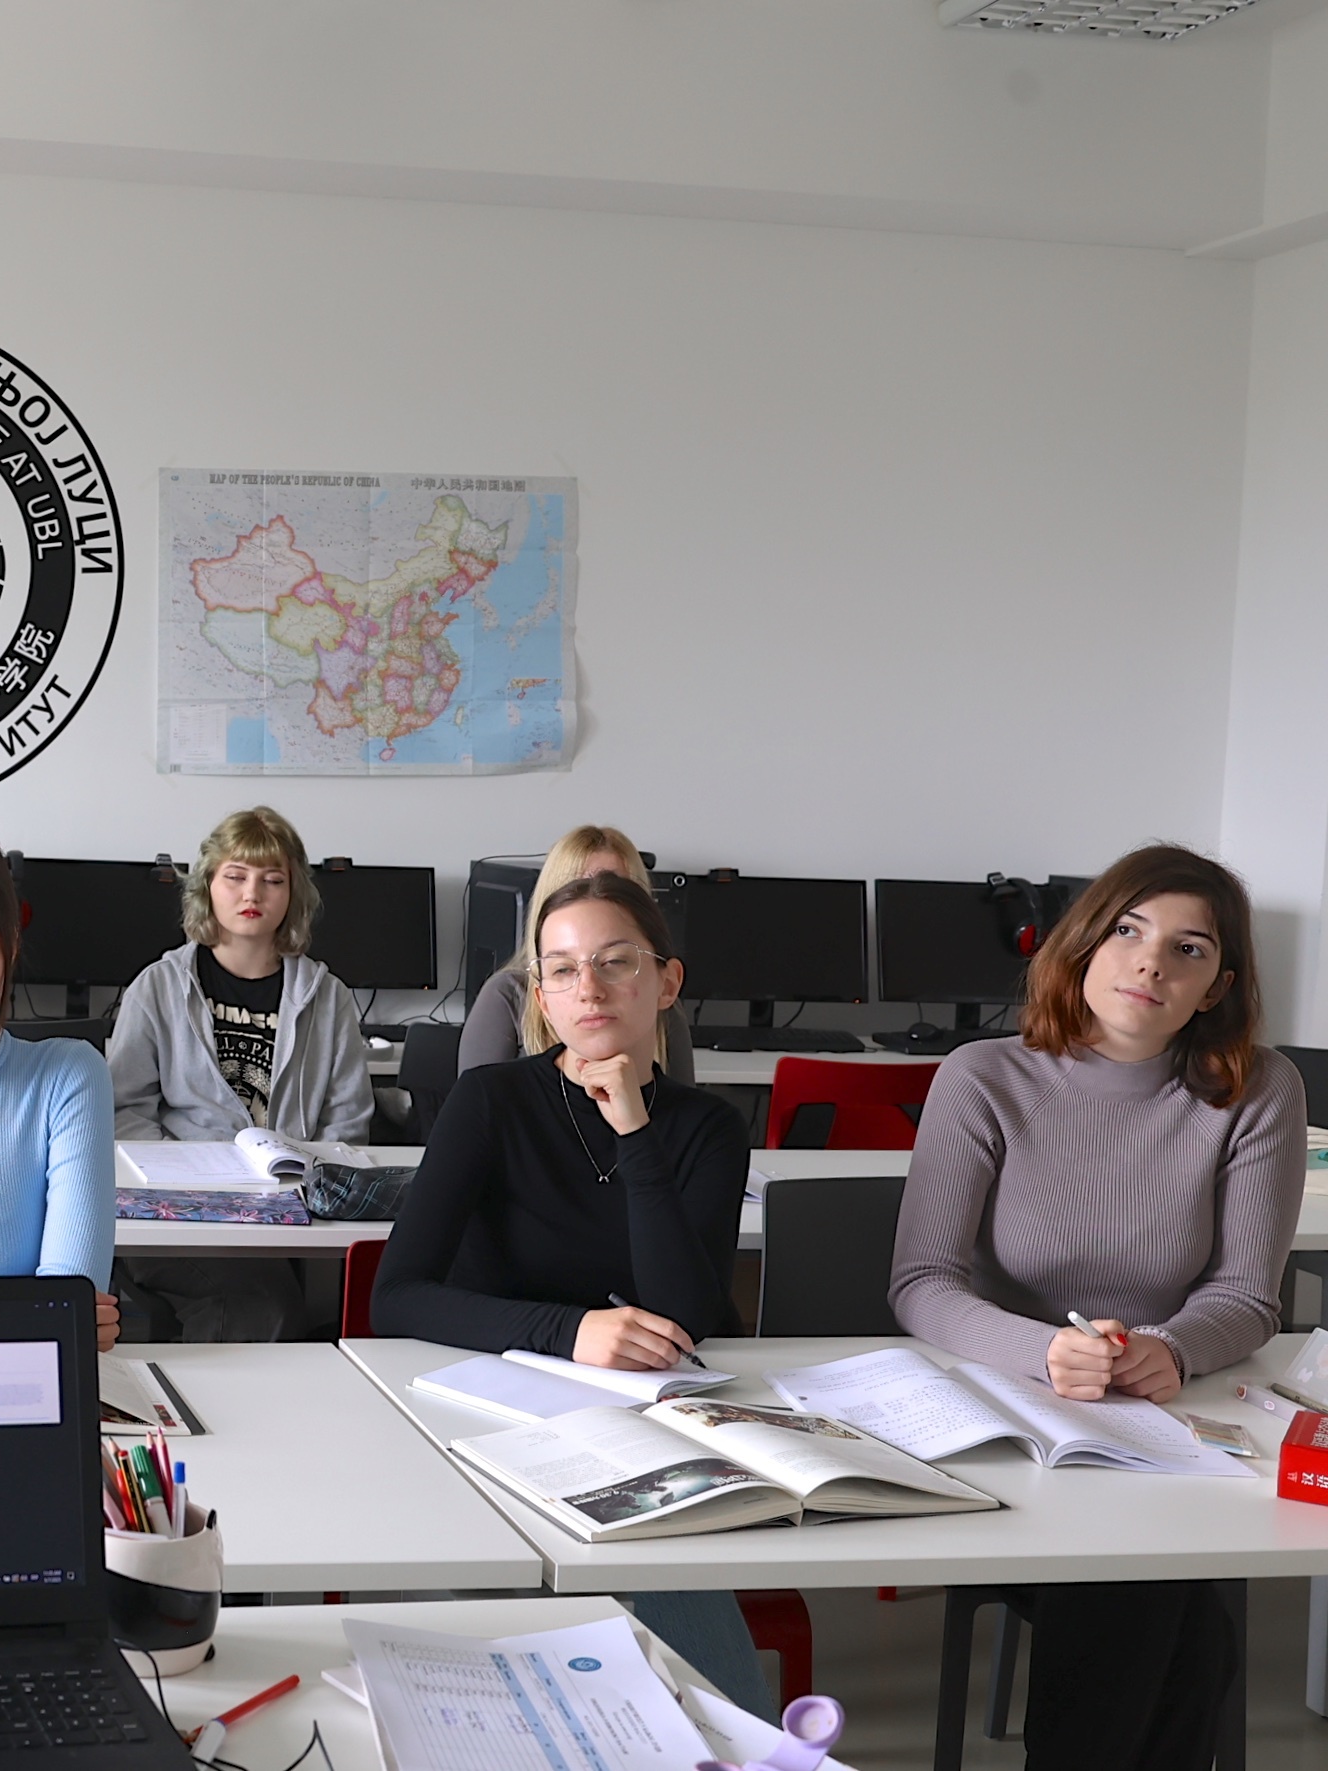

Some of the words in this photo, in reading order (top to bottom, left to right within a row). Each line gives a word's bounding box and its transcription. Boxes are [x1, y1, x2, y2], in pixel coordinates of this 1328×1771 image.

[0, 451, 44, 490] AT
[25, 494, 63, 560] UBL
[209, 473, 226, 484] MAP
[228, 474, 239, 484] OF
[242, 474, 258, 485] THE
[260, 474, 300, 486] PEOPLE'S
[302, 475, 341, 487] REPUBLIC
[343, 476, 354, 487] OF
[356, 476, 381, 488] CHINA
[410, 476, 526, 493] 中华人民共和国地图
[52, 453, 113, 575] ЛУЦИ
